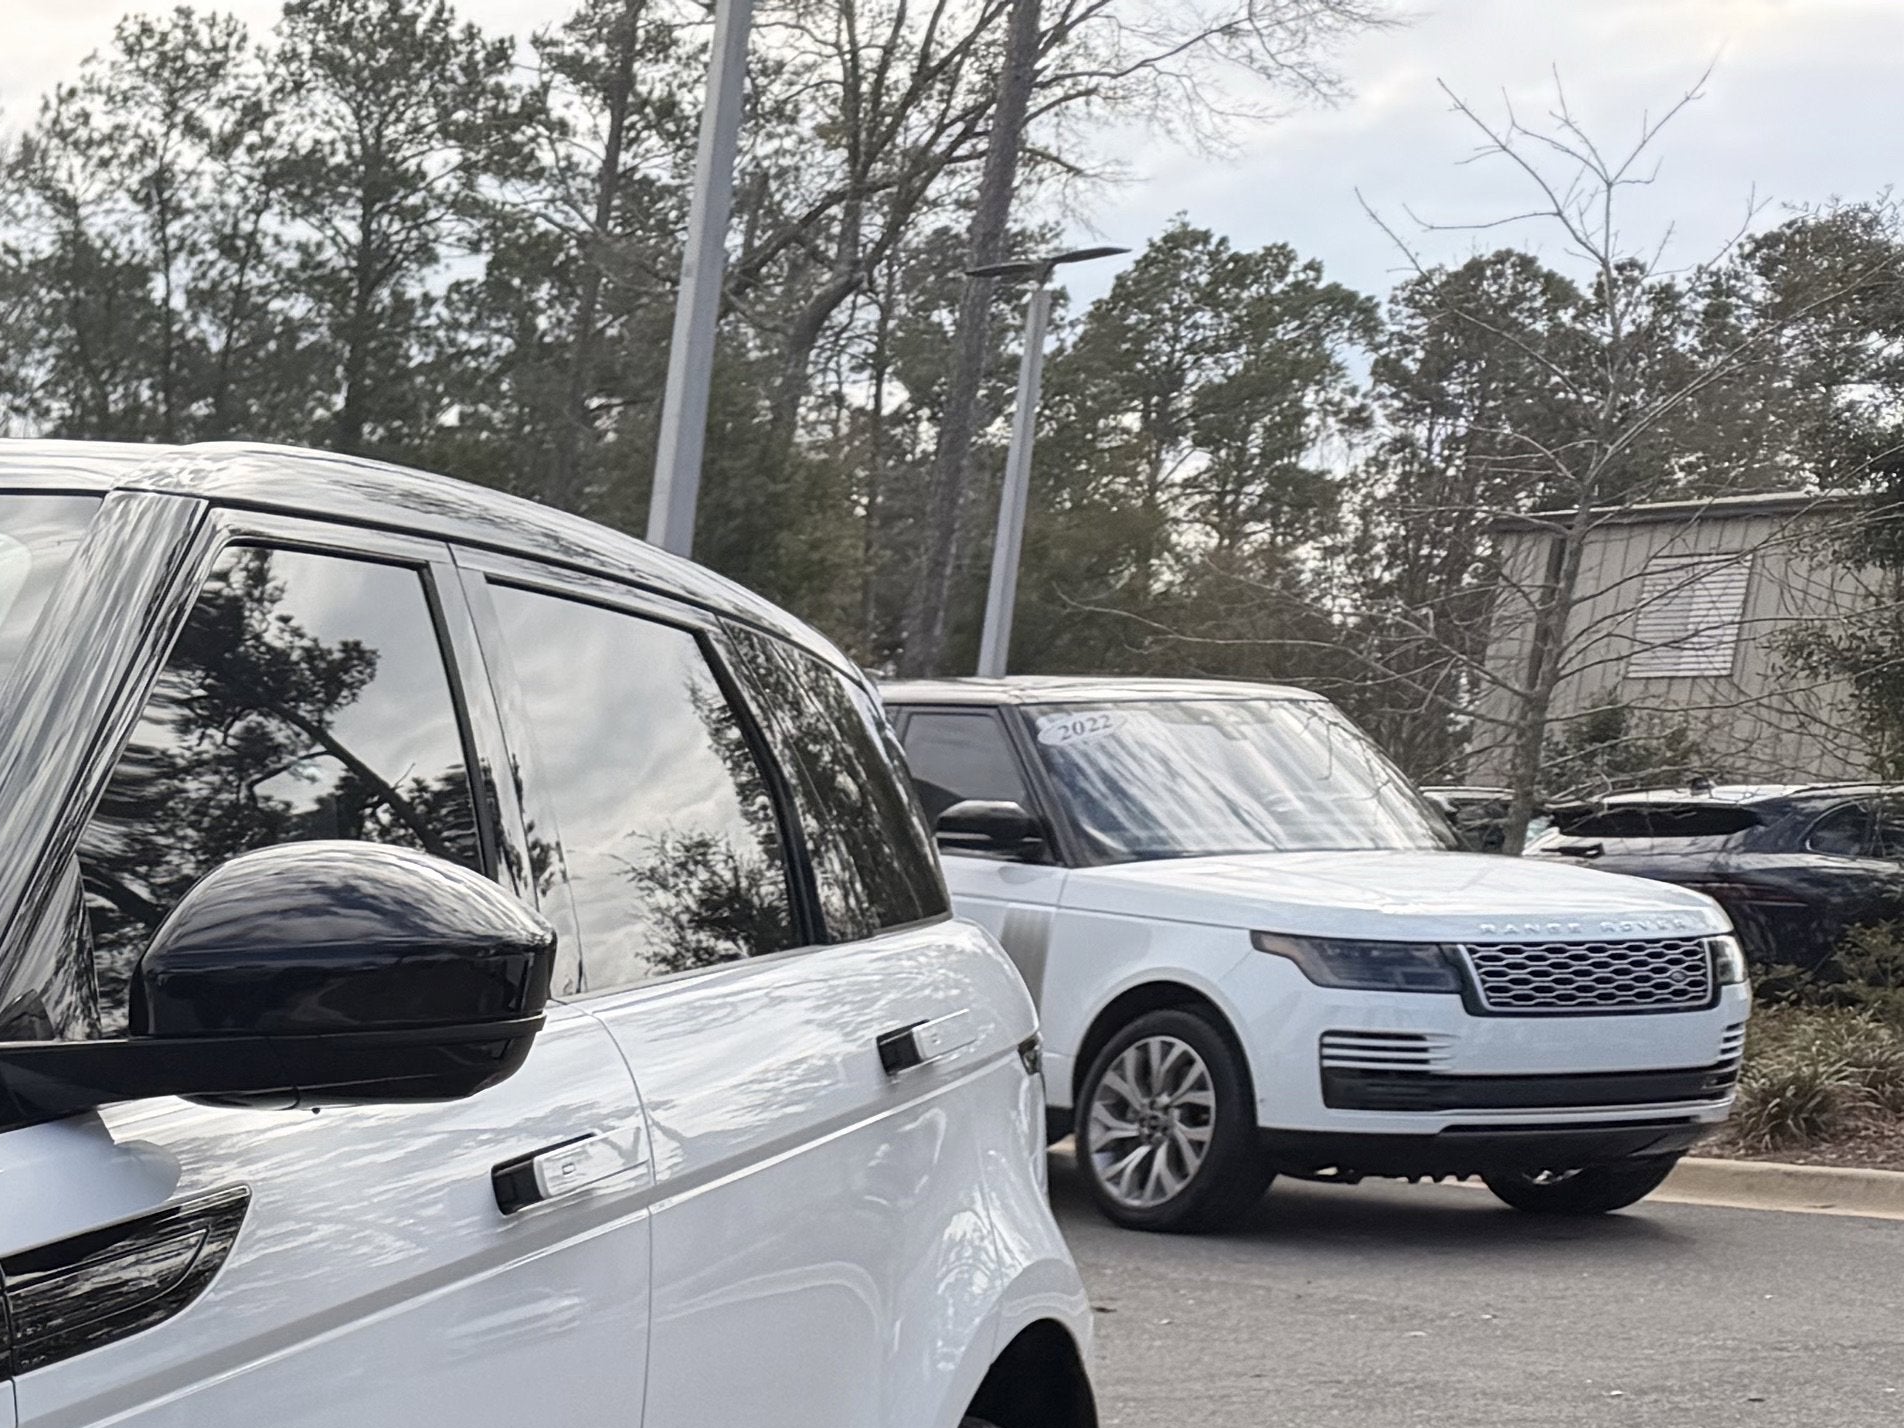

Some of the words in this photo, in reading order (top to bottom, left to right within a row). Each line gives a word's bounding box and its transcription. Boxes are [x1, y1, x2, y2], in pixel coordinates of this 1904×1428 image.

[1057, 714, 1113, 740] 2022
[1479, 923, 1584, 935] RANGE
[1599, 918, 1687, 933] ROVER
